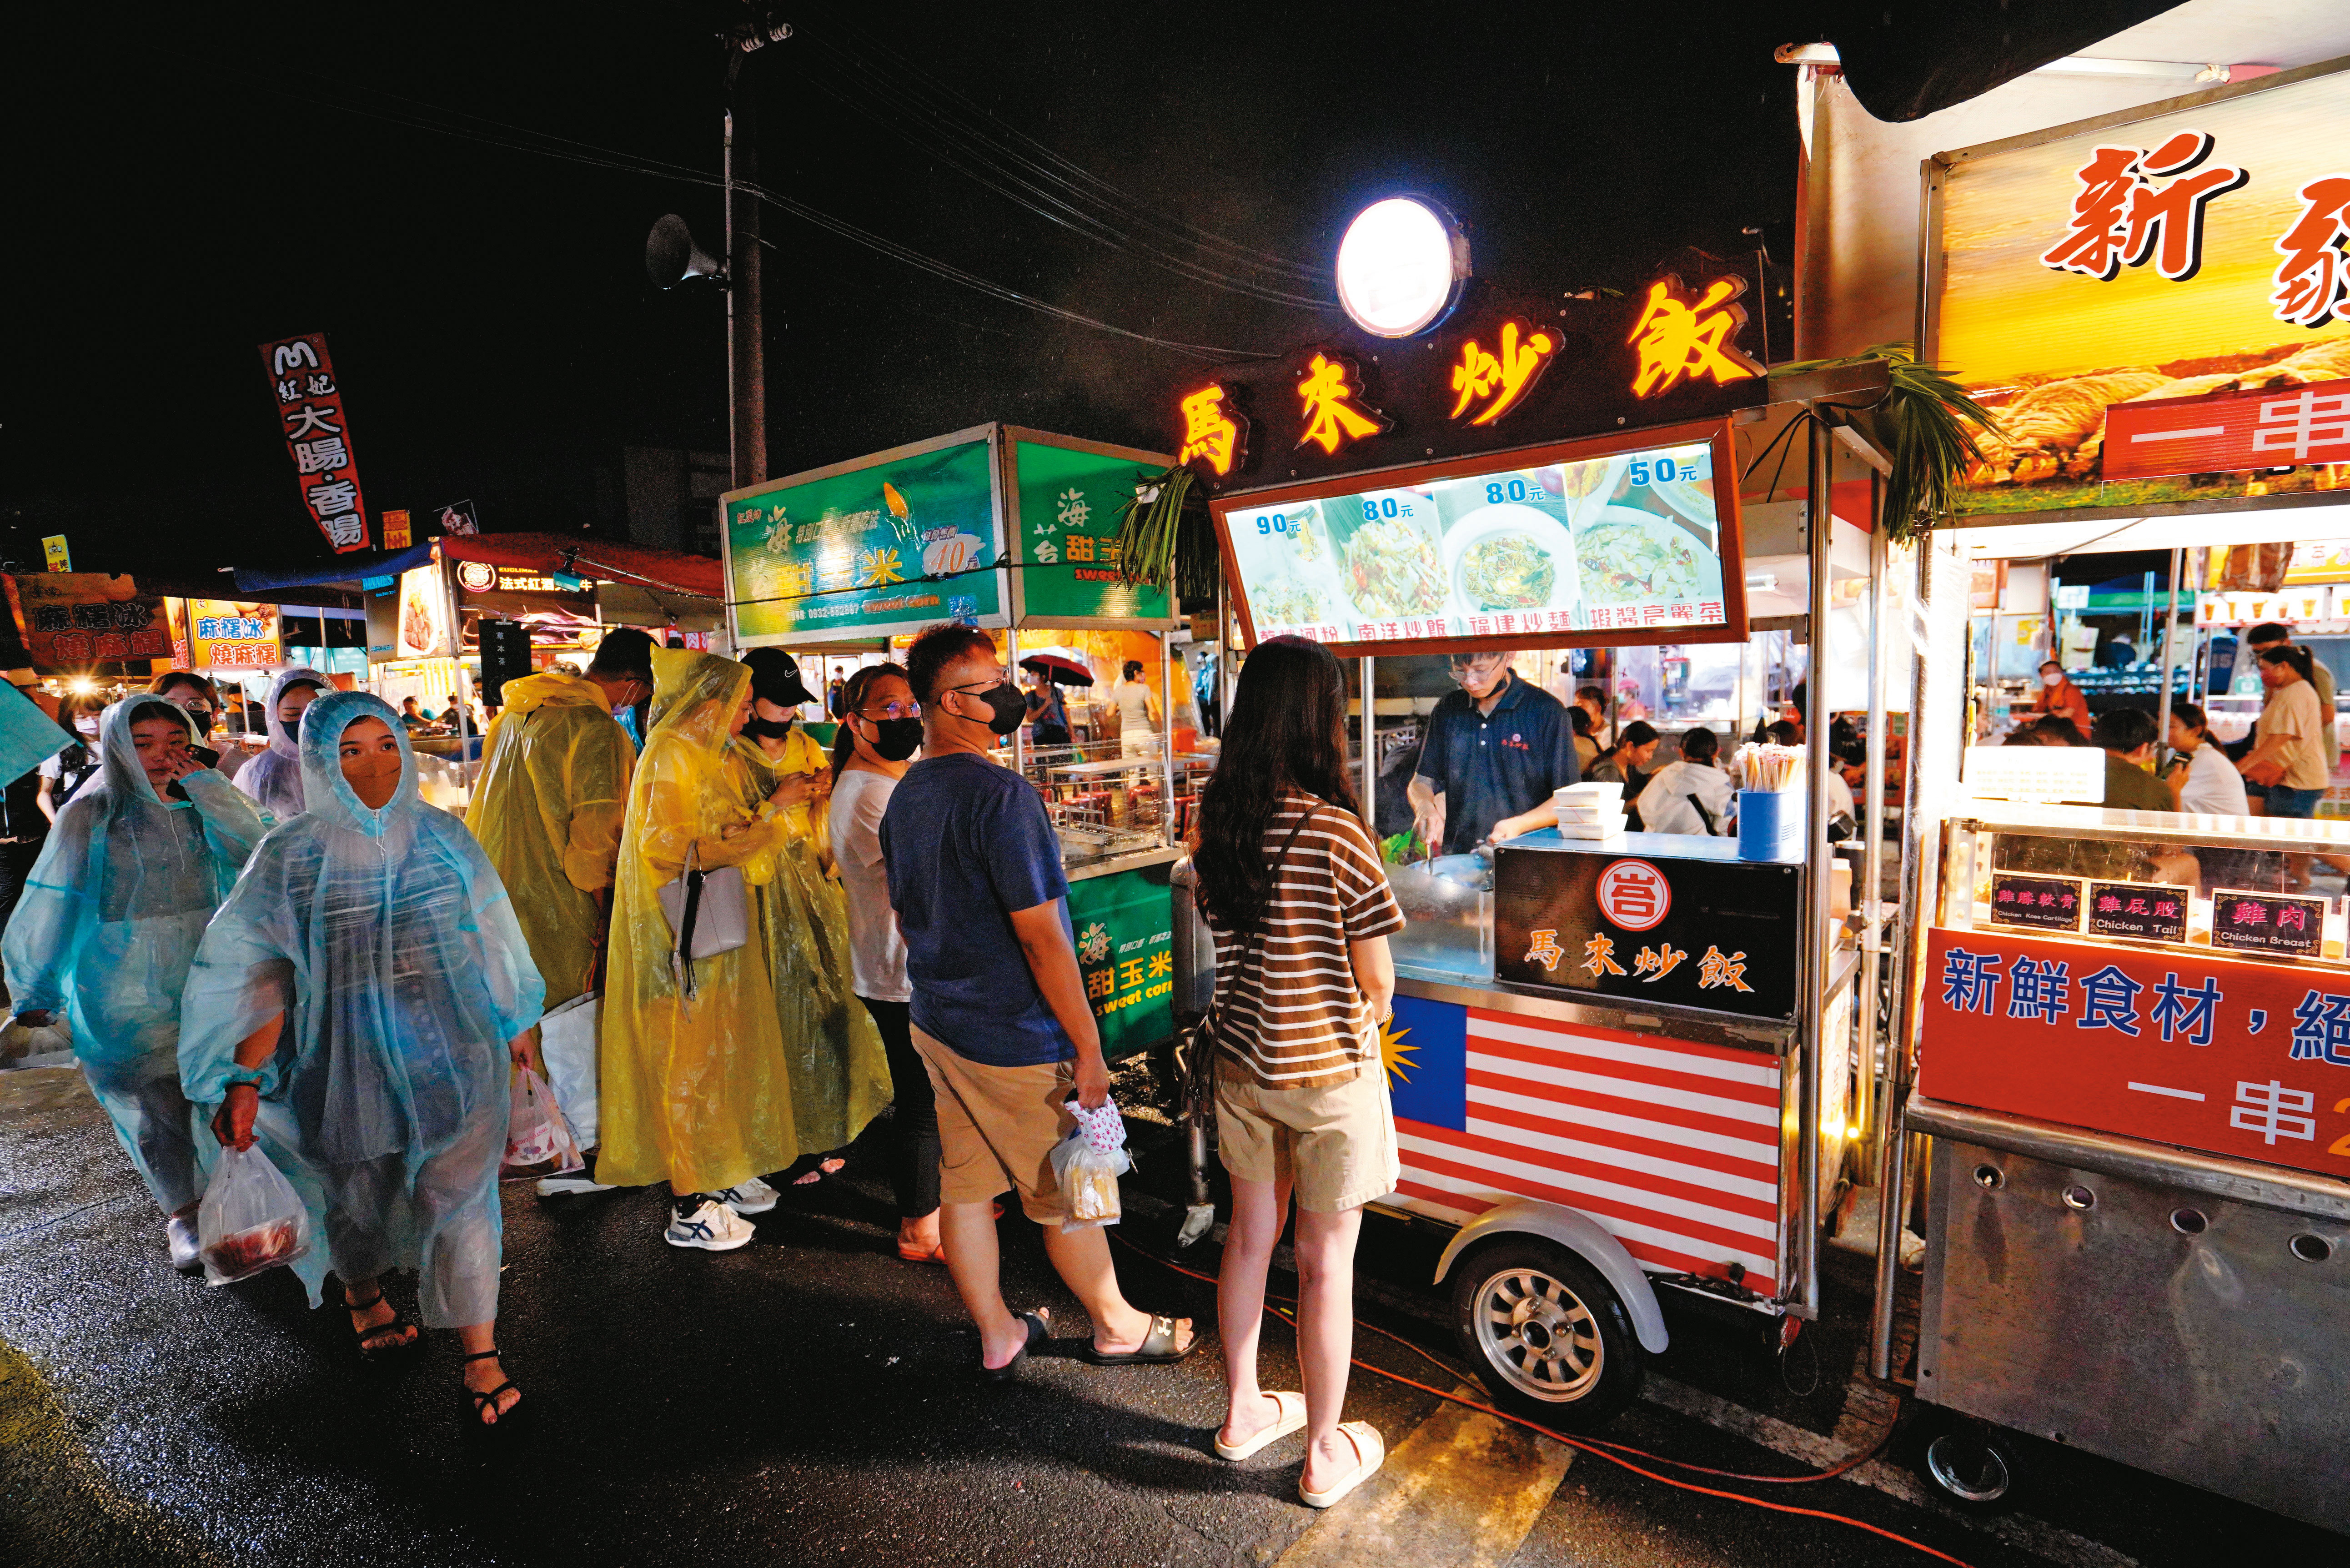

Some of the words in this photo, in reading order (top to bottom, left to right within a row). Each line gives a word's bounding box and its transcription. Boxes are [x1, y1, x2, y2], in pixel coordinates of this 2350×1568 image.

[1177, 276, 1755, 475] 馬來炒飯
[2130, 391, 2350, 460] 一串
[1629, 458, 1697, 486] 50元
[1486, 479, 1545, 504] 80元
[1364, 498, 1414, 521] 80元
[1256, 514, 1301, 535] 90元
[1066, 534, 1122, 564] 甜玉
[499, 577, 593, 592] 法式紅酒牛
[197, 617, 265, 640] 麻糬冰
[1357, 619, 1448, 641] 南洋炒飯
[210, 643, 277, 665] 燒麻糬
[2043, 915, 2073, 923] Cartilage
[2097, 895, 2179, 919] 雞屁股
[2231, 901, 2306, 931] 雞肉
[2096, 919, 2144, 932] Chicken
[2153, 924, 2177, 935] Tail
[2221, 932, 2266, 944] Chicken
[2270, 936, 2312, 948] Breast
[1524, 929, 1756, 993] 馬來炒飯
[1088, 950, 1172, 1000] 甜玉米
[1096, 989, 1142, 1017] sweet
